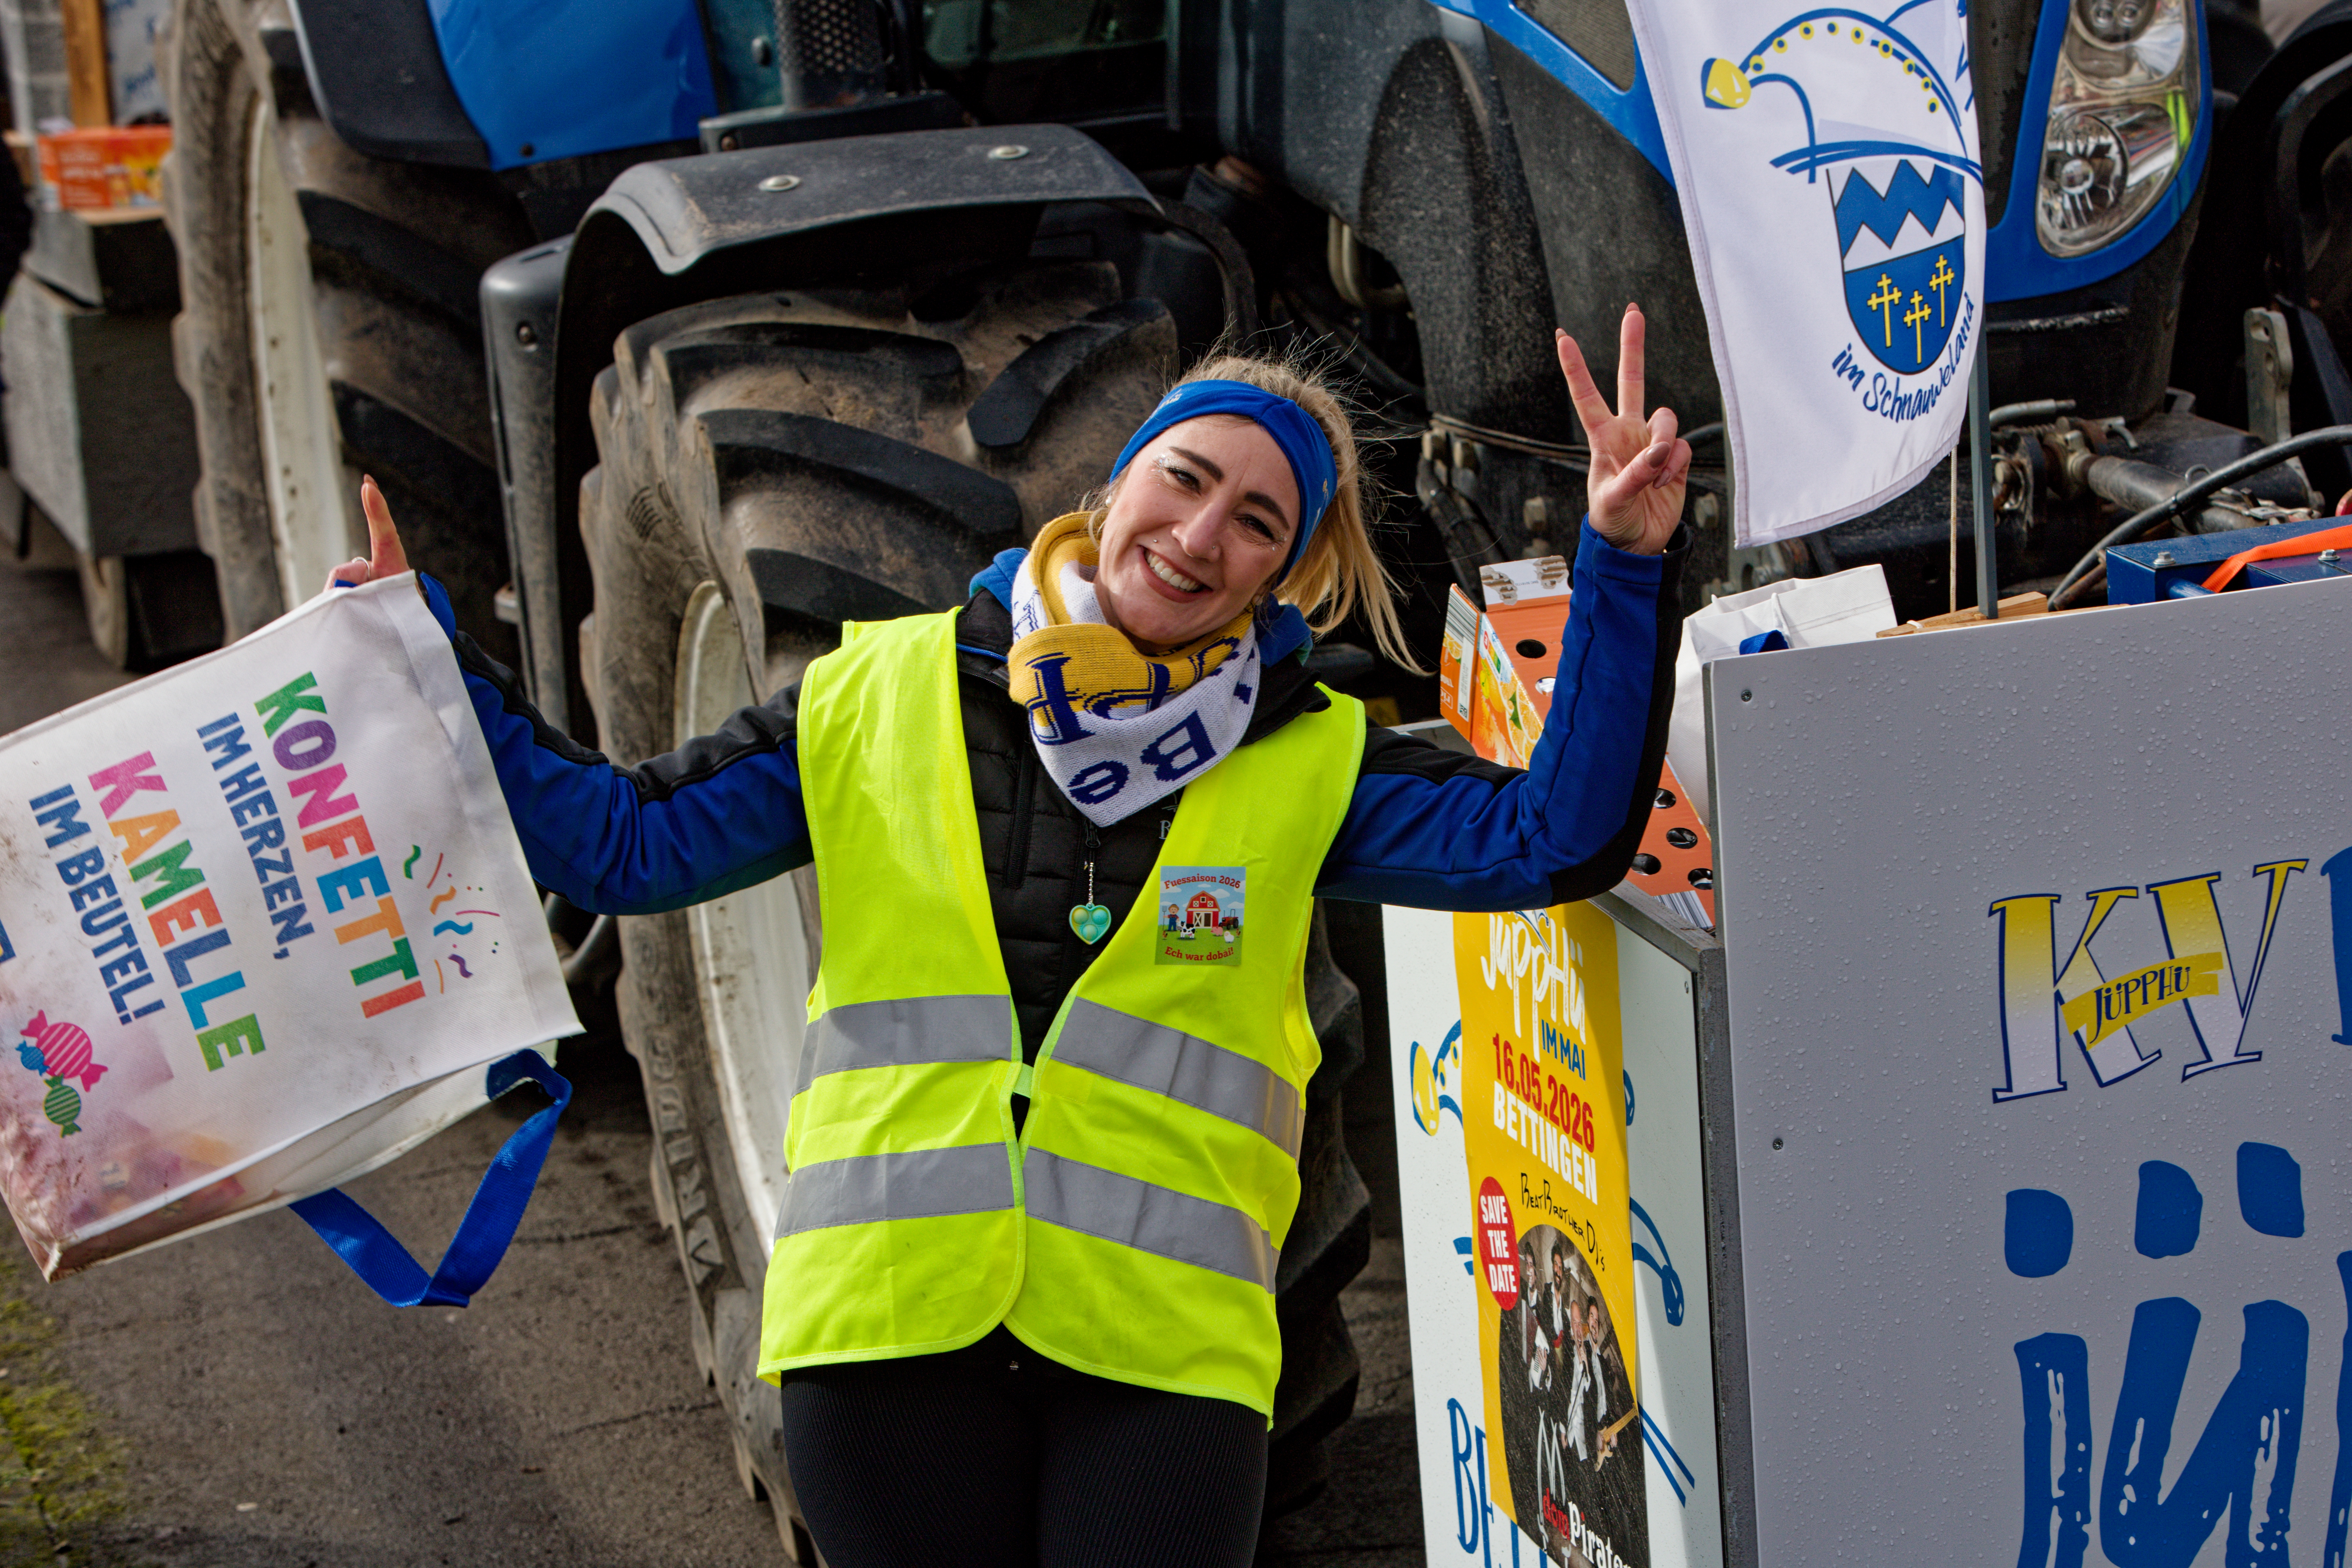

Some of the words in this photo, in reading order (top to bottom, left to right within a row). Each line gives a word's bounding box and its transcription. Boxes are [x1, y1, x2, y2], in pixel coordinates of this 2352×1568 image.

[1832, 342, 1865, 392] im
[1863, 291, 1975, 424] Schnauweland
[196, 711, 253, 771] IM
[29, 784, 91, 849] IM
[219, 760, 315, 960] HERZEN,
[254, 671, 425, 1019] KONFETTI
[88, 750, 267, 1073] KAMELLE
[1164, 873, 1217, 889] Fuessaison
[1218, 875, 1241, 889] 2026
[56, 844, 166, 1025] BEUTEL!
[1165, 946, 1183, 959] Ech
[1206, 946, 1234, 960] dobäi!
[1988, 858, 2309, 1103] KV
[1492, 1032, 1594, 1153] 16.05.2026
[1541, 1018, 1557, 1060] IM
[1559, 1032, 1586, 1082] MAI
[1494, 1080, 1598, 1206] BETTINGEN
[1480, 1195, 1508, 1224] SAVE
[1487, 1230, 1510, 1258] THE
[1489, 1264, 1517, 1293] DATE
